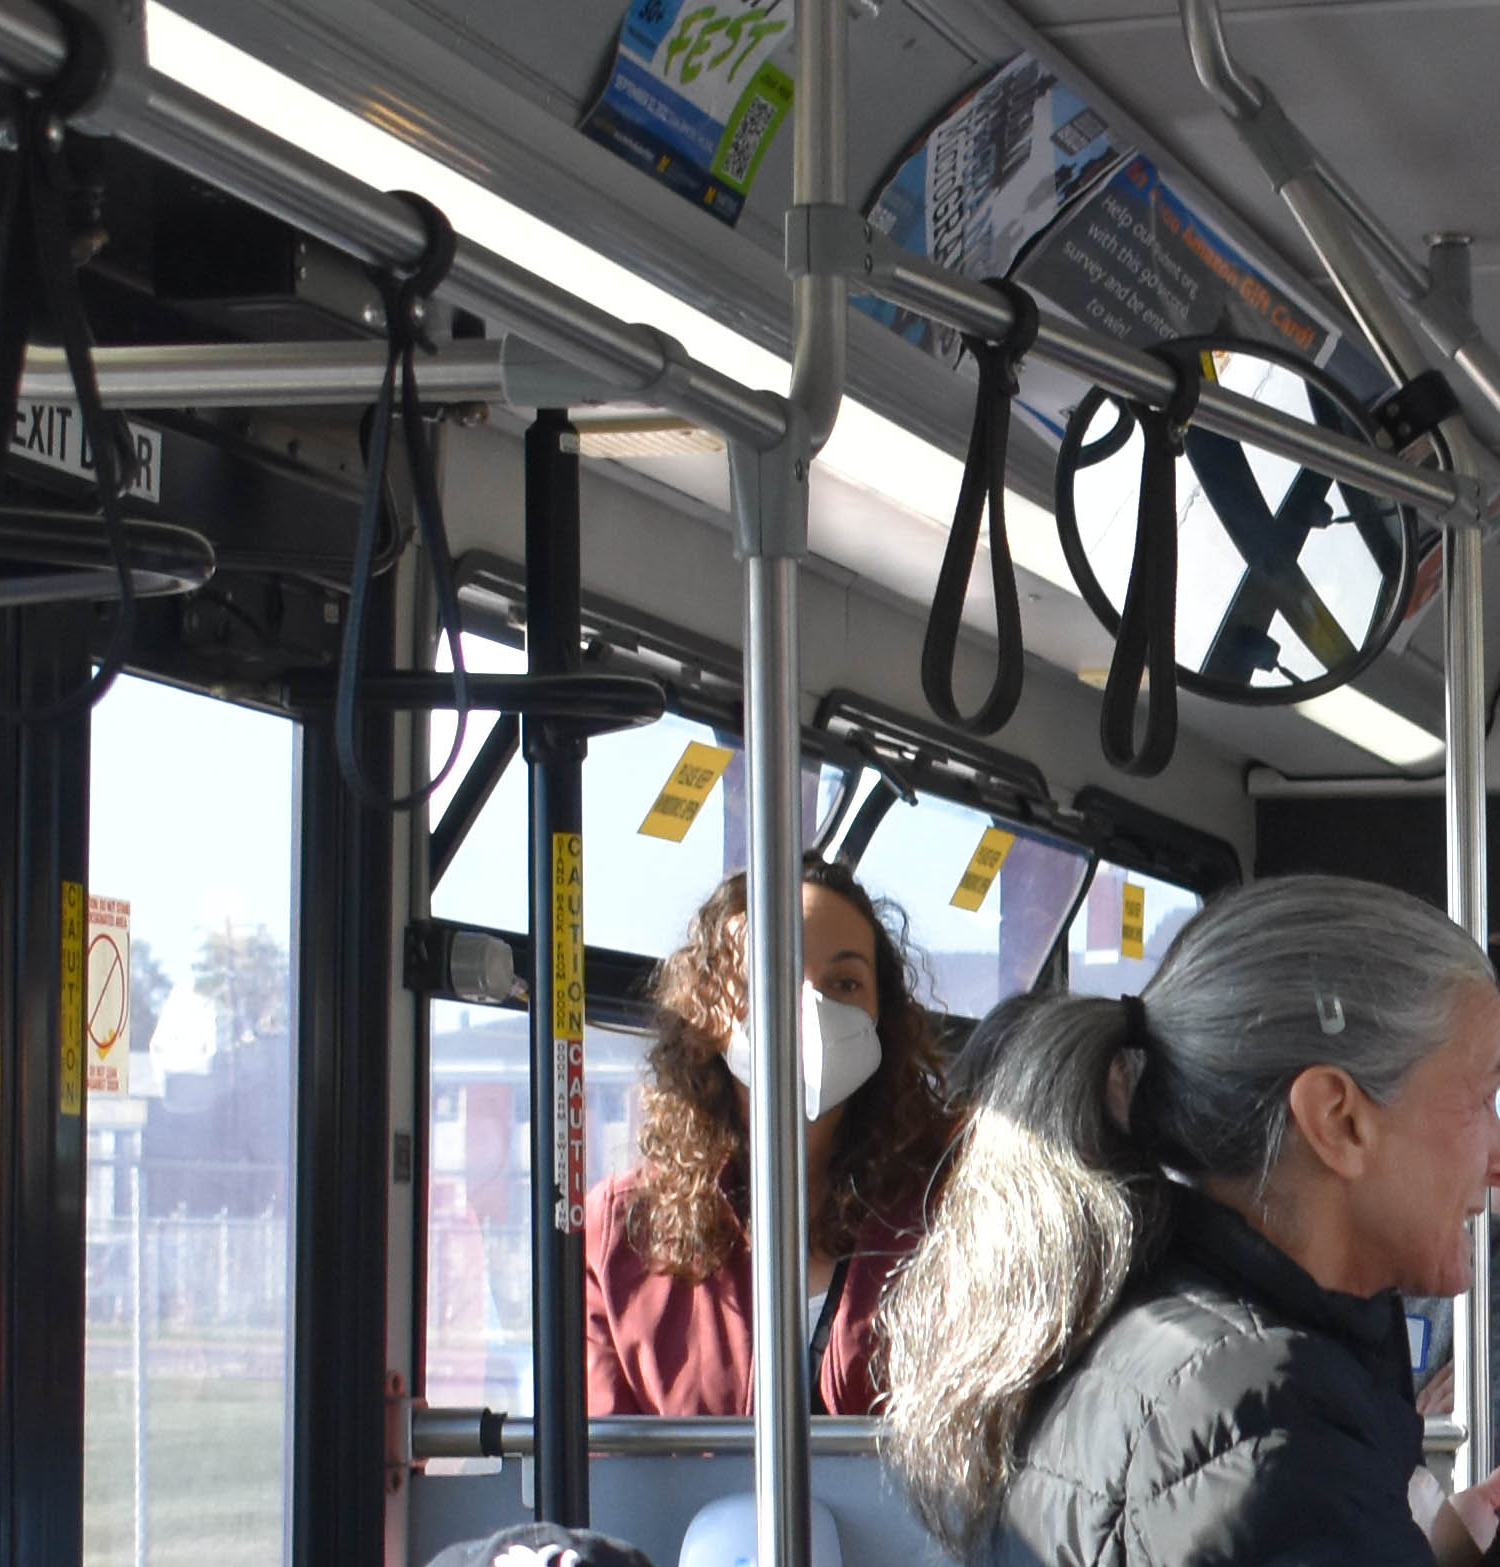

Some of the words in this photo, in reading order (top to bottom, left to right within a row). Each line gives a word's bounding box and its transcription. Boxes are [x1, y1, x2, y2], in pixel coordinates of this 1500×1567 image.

[1100, 194, 1133, 229] Help
[1062, 240, 1105, 284] survey
[1103, 272, 1129, 301] and
[1087, 222, 1118, 253] with
[1116, 241, 1143, 275] this
[1085, 296, 1104, 320] to
[1102, 312, 1132, 340] win!
[1238, 273, 1271, 314] Gift
[1270, 302, 1317, 350] Card!
[13, 404, 73, 462] EXIT
[80, 412, 153, 492] DR
[566, 836, 583, 1034] CAUTION
[64, 884, 77, 1106] CAUTION
[556, 1042, 566, 1082] DOOR
[556, 1092, 567, 1122] ARM
